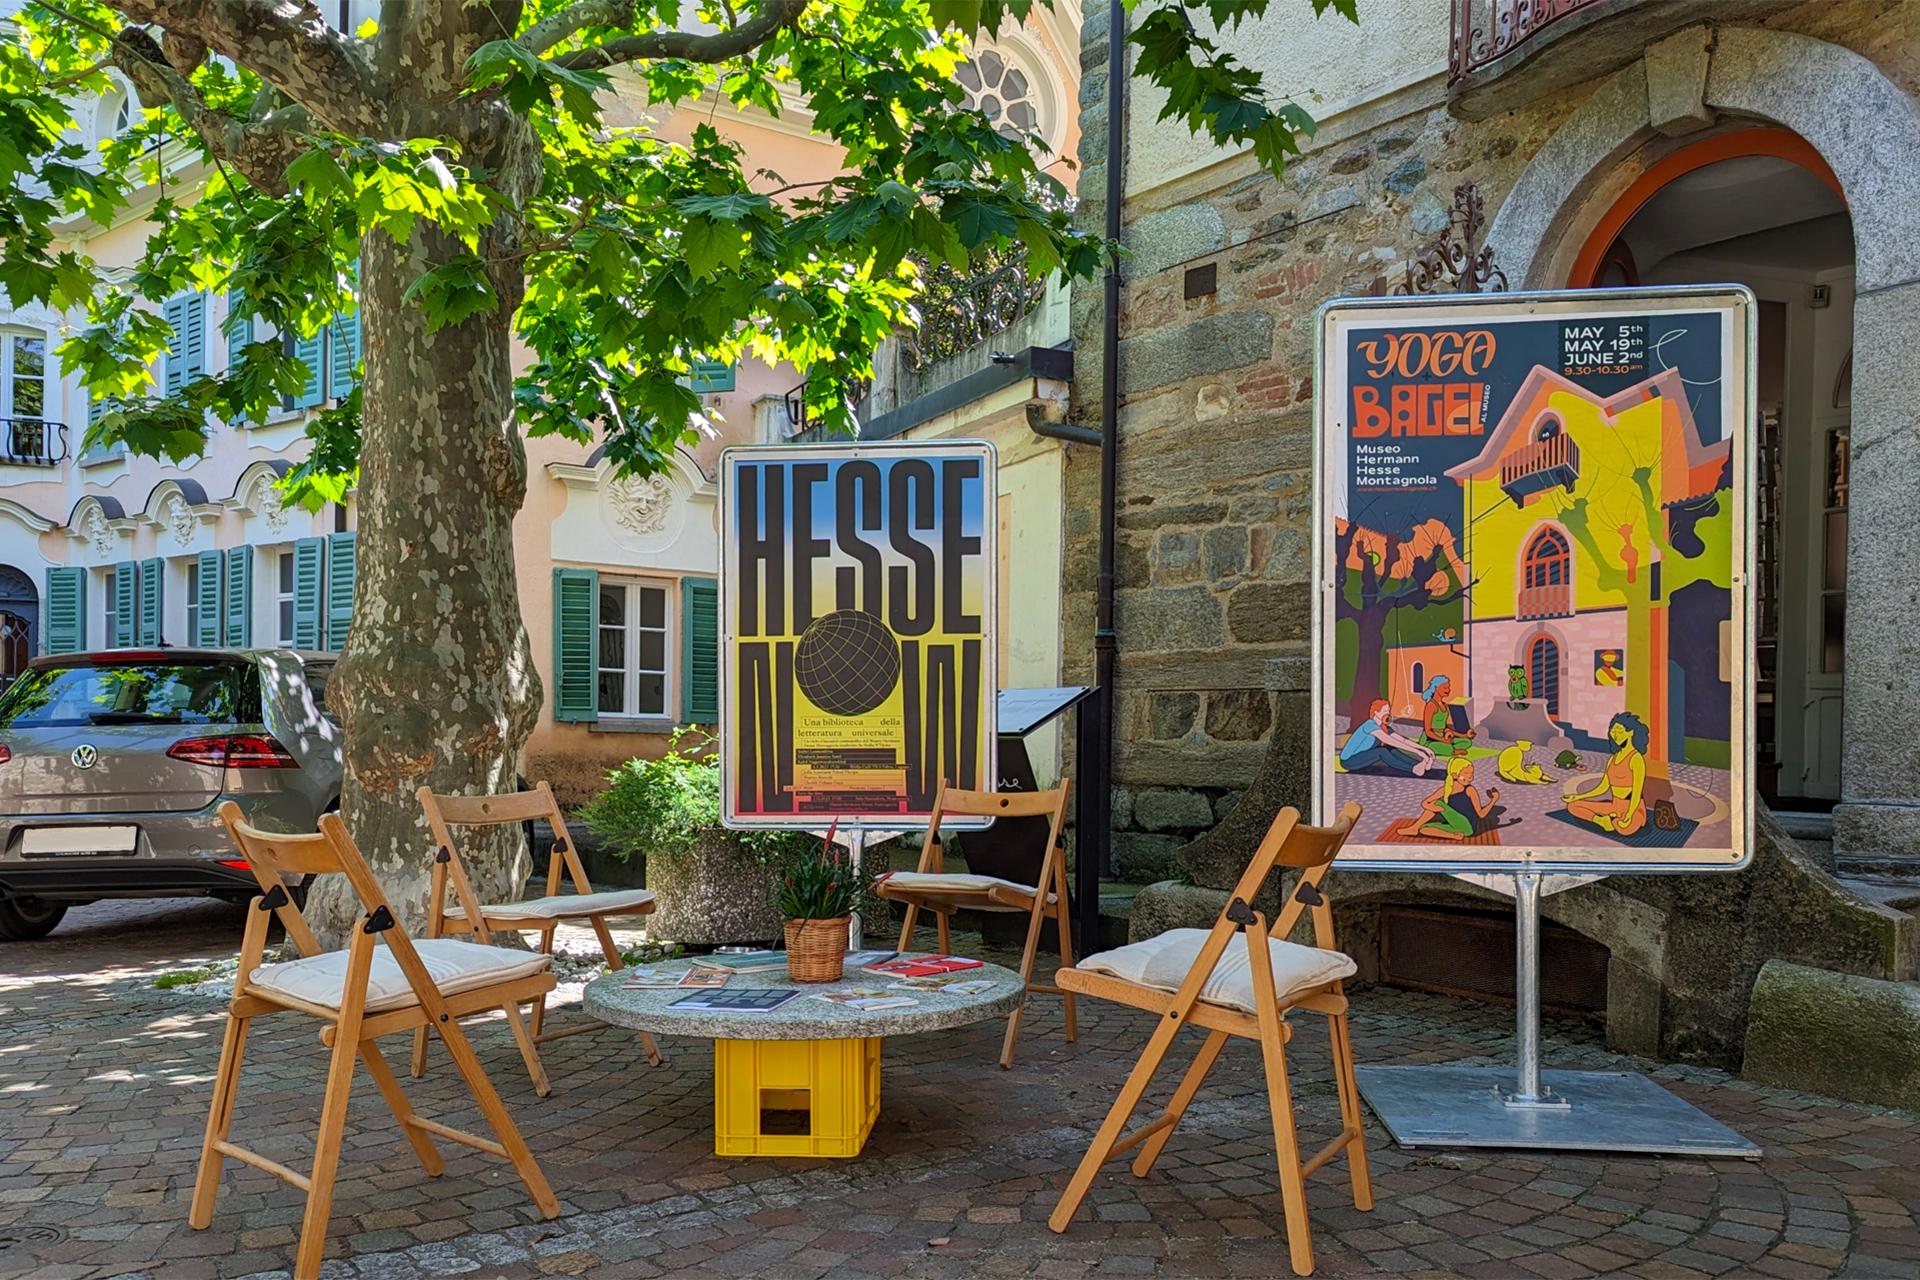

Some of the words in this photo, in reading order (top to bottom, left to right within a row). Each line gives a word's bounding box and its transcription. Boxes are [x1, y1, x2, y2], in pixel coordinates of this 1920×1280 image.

[1565, 327, 1604, 339] MAY
[1619, 325, 1643, 338] 5th
[1565, 340, 1604, 352] MAY
[1609, 338, 1643, 351] 19th
[1356, 330, 1497, 378] YOGA
[1564, 352, 1614, 365] JUNE
[1618, 351, 1643, 364] 2nd
[1483, 384, 1491, 412] MUSEO
[1352, 383, 1485, 437] BAGEL
[1356, 444, 1400, 454] Museo
[1356, 455, 1419, 464] Hermann
[1356, 466, 1400, 475] Hesse
[1356, 475, 1437, 487] Montagnola
[738, 459, 982, 637] HESSE
[803, 718, 820, 726] Una
[822, 718, 864, 726] biblioteca
[880, 718, 900, 726] della
[797, 729, 842, 737] letteratura
[851, 729, 894, 737] universale
[71, 744, 98, 769] VW
